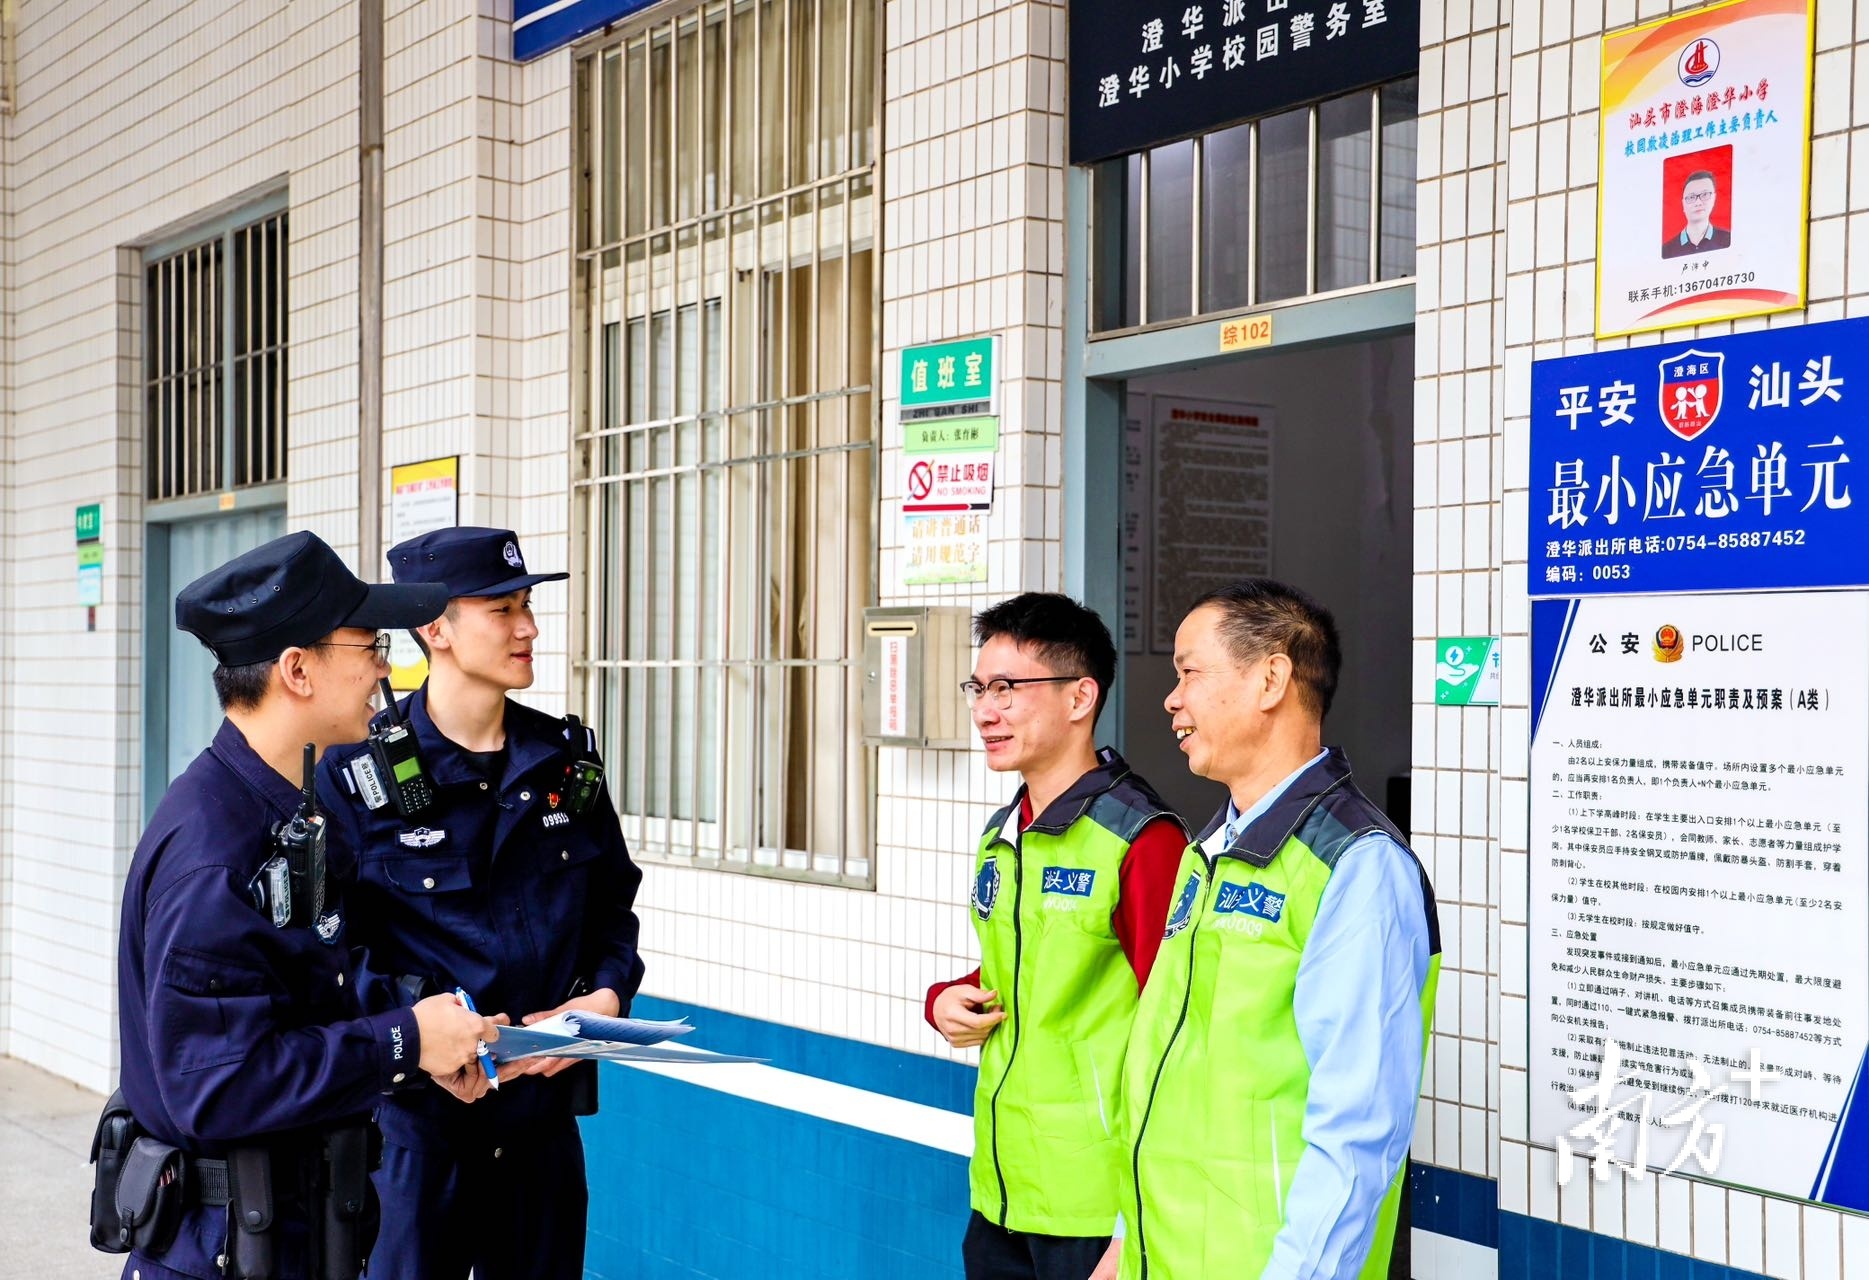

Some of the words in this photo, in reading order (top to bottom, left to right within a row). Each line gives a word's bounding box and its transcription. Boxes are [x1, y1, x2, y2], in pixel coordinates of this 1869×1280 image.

[1098, 0, 1388, 108] 澄华小学校园警务室
[1628, 78, 1770, 131] 汕头市澄海澄华小学
[1628, 271, 1755, 303] 联系手机:13670478730
[1223, 321, 1269, 345] 综102
[911, 351, 983, 393] 值班室
[1674, 362, 1709, 378] 澄海区
[1555, 380, 1637, 430] 平安
[1748, 355, 1844, 410] 汕头
[912, 409, 928, 419] ZHI
[961, 403, 979, 414] SHI
[937, 463, 989, 483] 禁止吸烟
[1547, 434, 1852, 530] 最小应急单元
[937, 487, 948, 496] NO
[951, 485, 986, 495] SMOKING
[1589, 632, 1640, 654] 公安
[1692, 634, 1763, 651] POLICE
[365, 769, 379, 796] POLICE
[391, 1025, 404, 1060] POLICE
